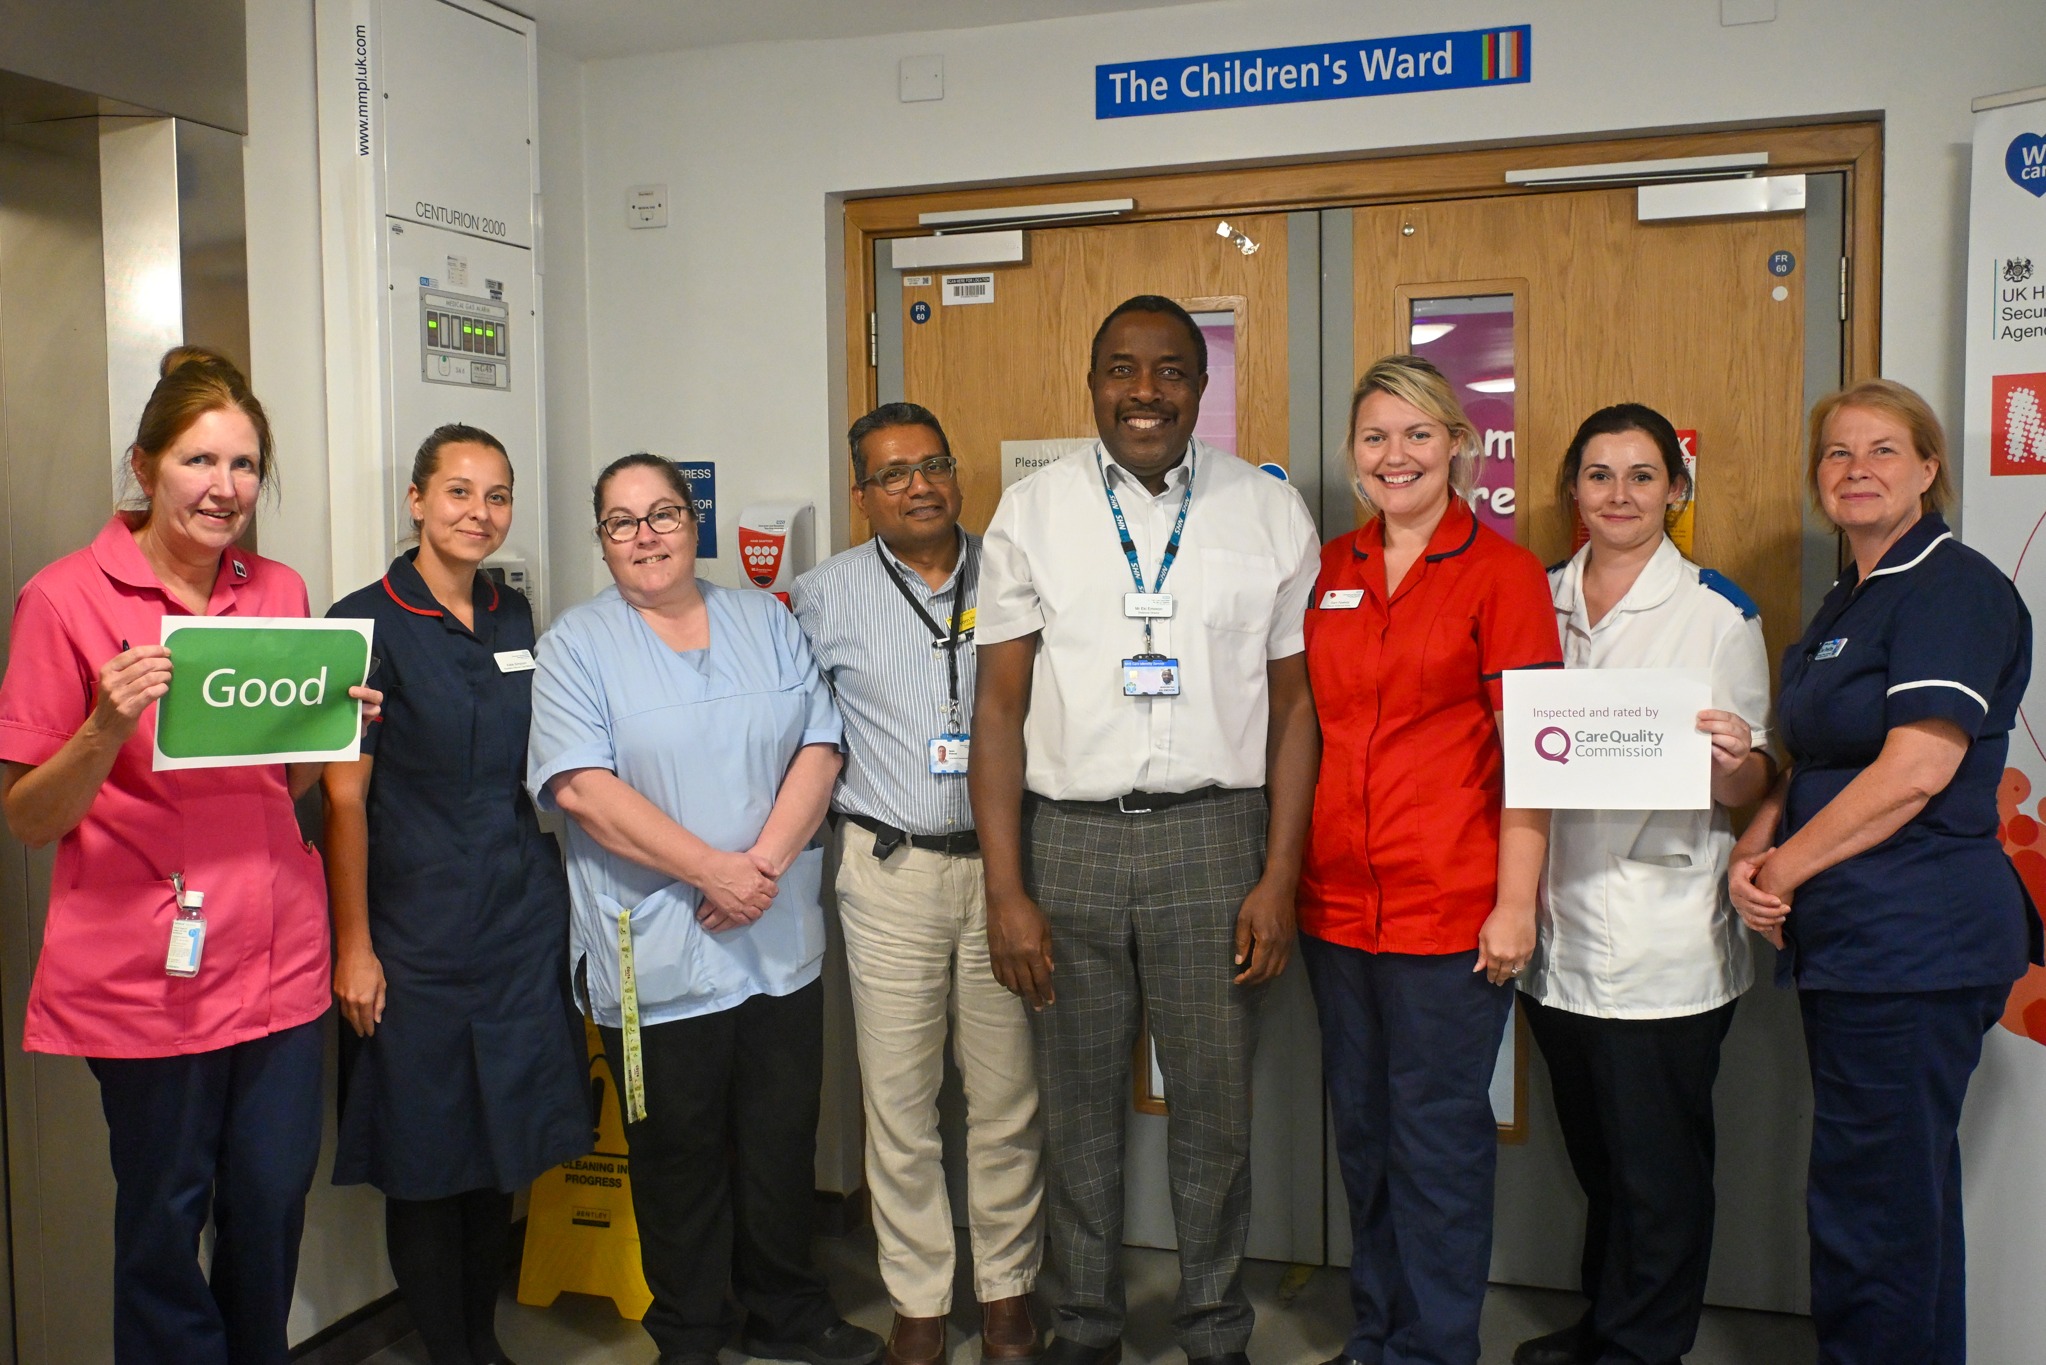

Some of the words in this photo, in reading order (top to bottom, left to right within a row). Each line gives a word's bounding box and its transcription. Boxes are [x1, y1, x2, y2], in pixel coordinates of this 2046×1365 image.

[1109, 70, 1169, 104] The
[1180, 54, 1348, 98] Children's
[1359, 40, 1453, 82] Ward
[355, 25, 370, 156] www.mmpl.uk.com
[416, 202, 479, 230] CENTURION
[482, 218, 506, 237] 2000
[1775, 254, 1788, 263] FR
[1776, 264, 1787, 273] 60
[2003, 287, 2028, 303] UK
[916, 313, 925, 321] 60
[2001, 326, 2046, 342] Agen
[1015, 457, 1049, 468] Please
[1115, 514, 1126, 530] NHS
[1174, 517, 1184, 535] NHS
[202, 666, 327, 708] Good
[1533, 707, 1585, 719] Inspected
[1589, 707, 1609, 718] and
[1613, 706, 1641, 718] rated
[1645, 706, 1659, 719] by
[1575, 745, 1663, 757] Commission
[561, 1160, 614, 1173] CLEANING
[617, 1164, 628, 1174] IN
[565, 1173, 622, 1188] PROGRESS
